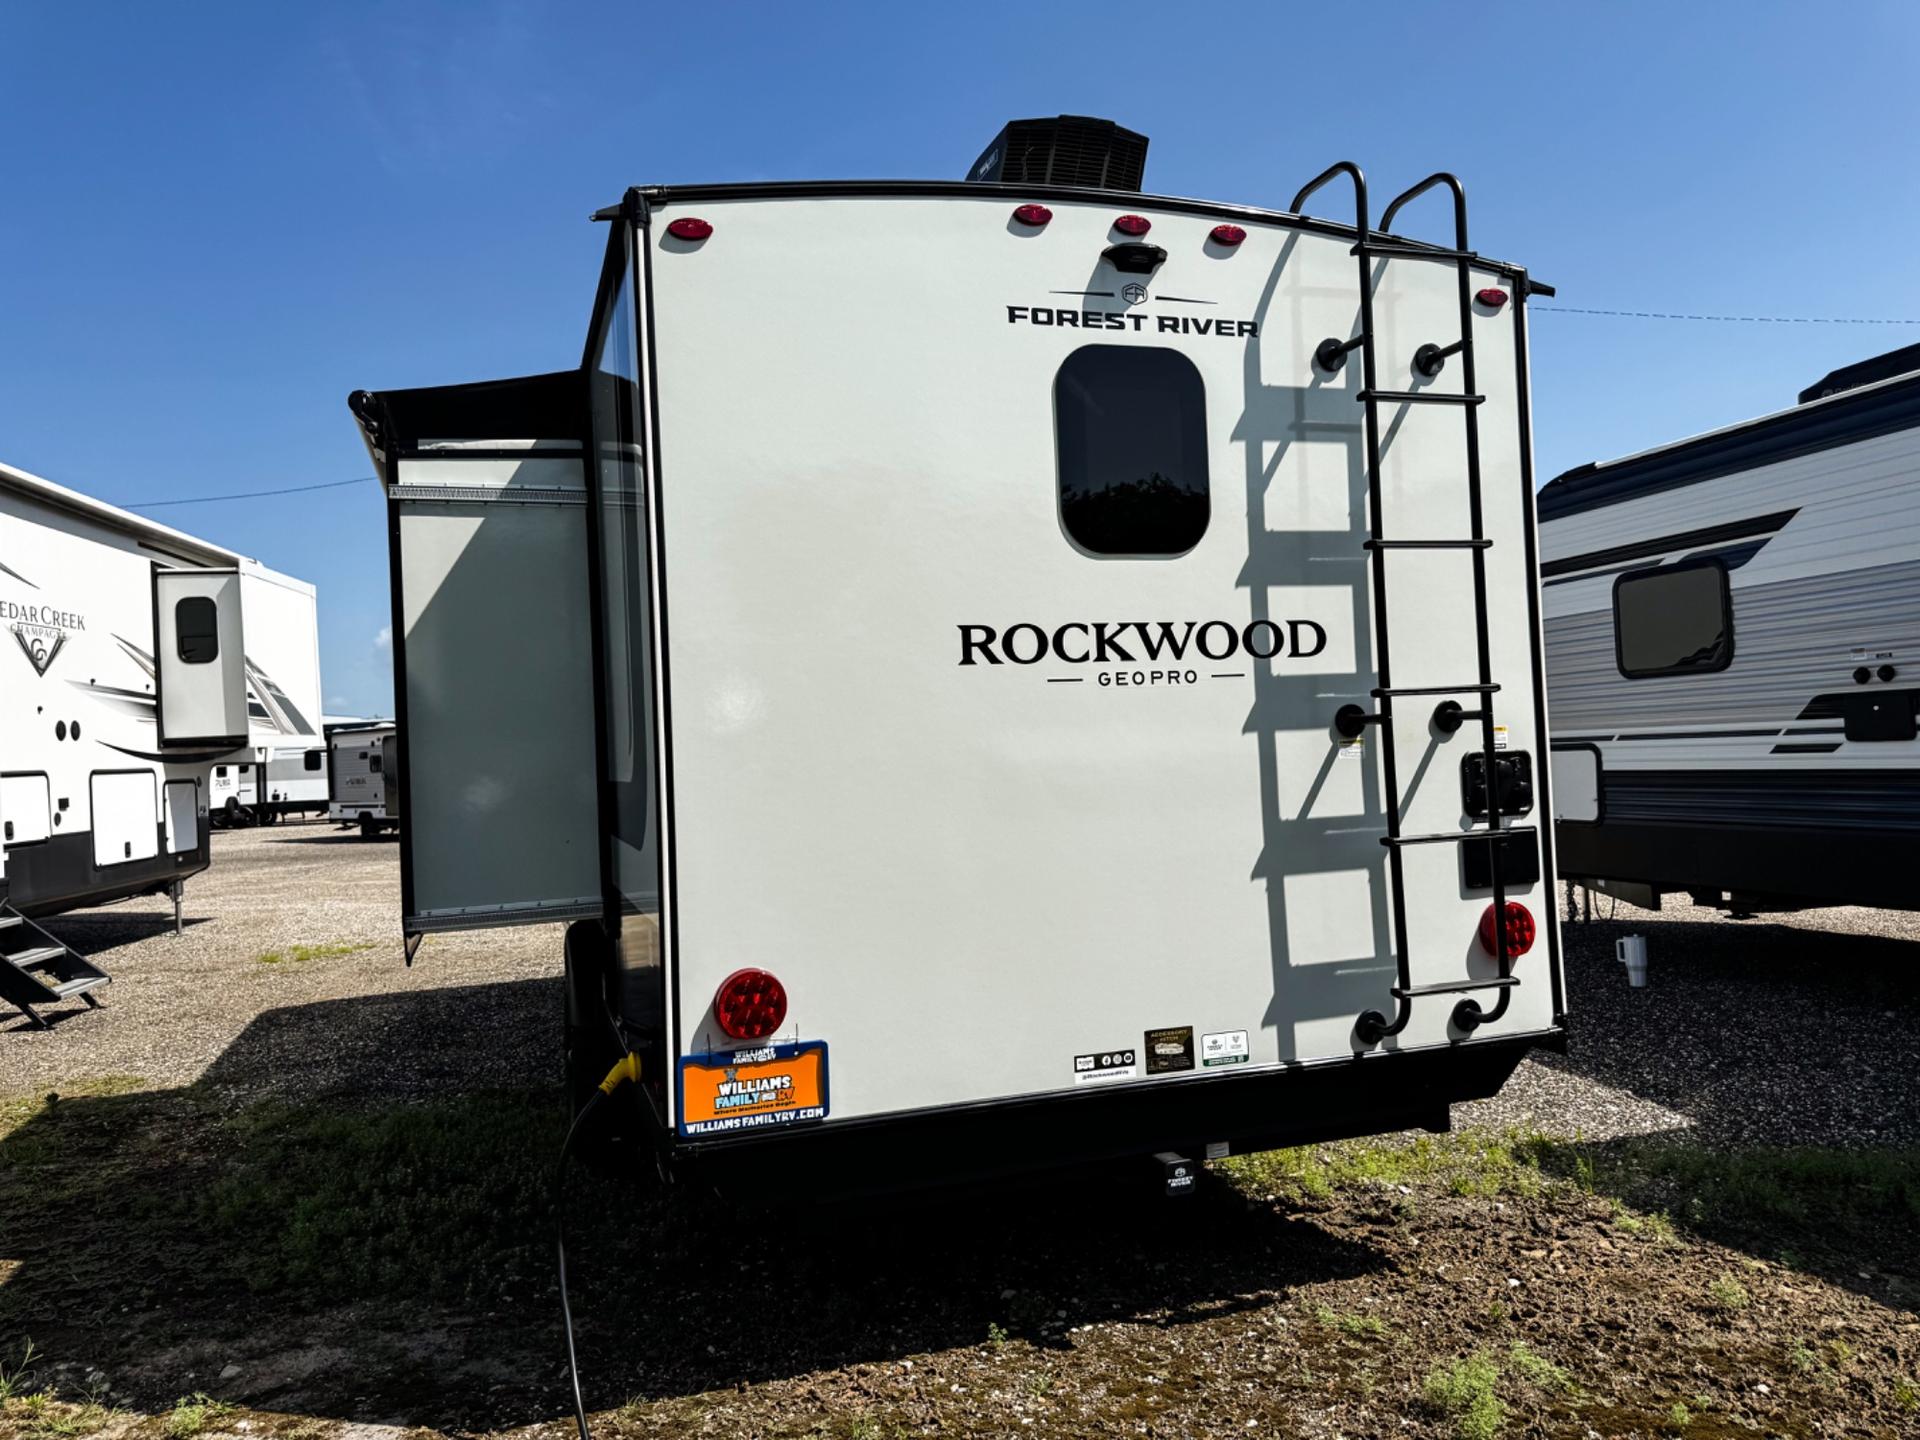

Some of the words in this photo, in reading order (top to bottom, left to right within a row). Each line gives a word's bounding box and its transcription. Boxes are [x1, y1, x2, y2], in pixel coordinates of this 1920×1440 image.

[1006, 305, 1148, 331] FOREST
[1156, 315, 1259, 338] RIVER
[41, 605, 86, 631] CREEK
[957, 619, 1328, 666] ROCKWOOD
[1097, 669, 1198, 687] GEOPRO
[735, 1047, 776, 1059] WILLIAMS
[718, 1075, 792, 1097] WILLIAMS
[714, 1091, 760, 1109] FAMILY
